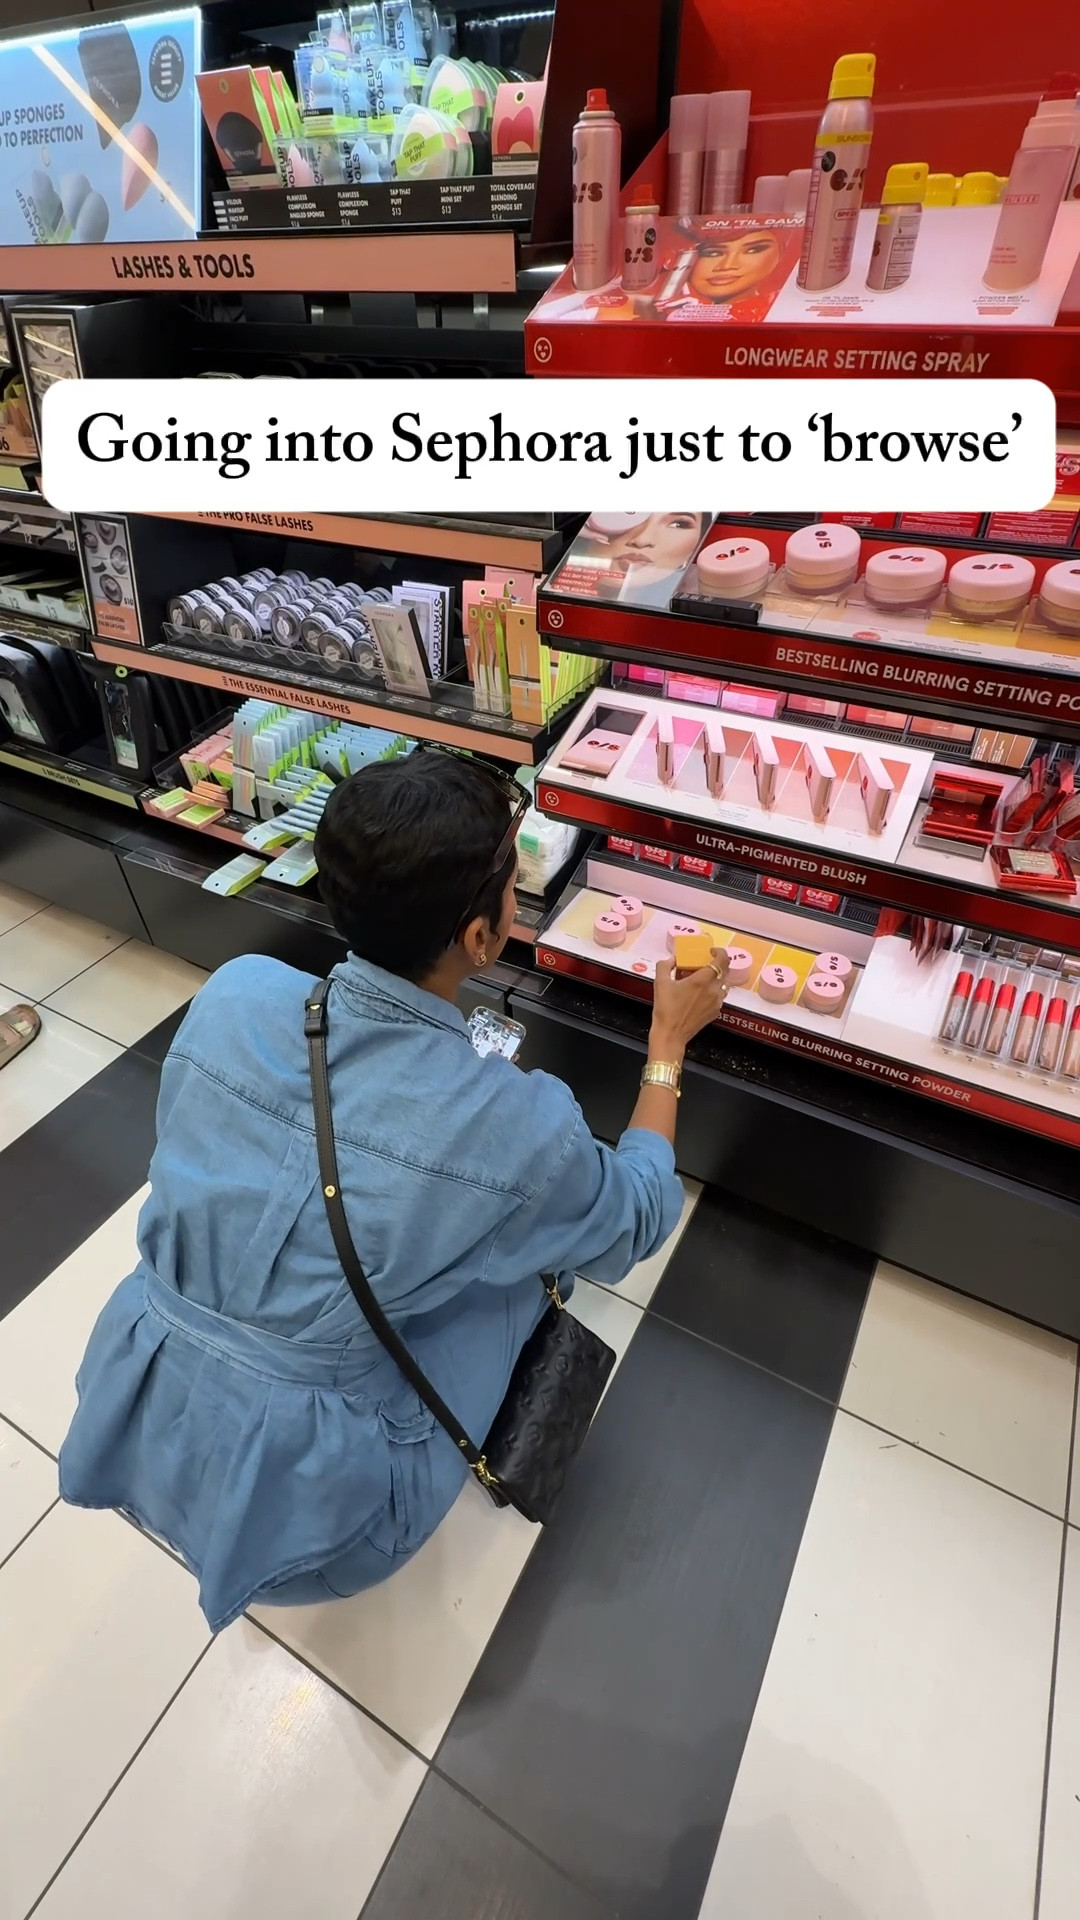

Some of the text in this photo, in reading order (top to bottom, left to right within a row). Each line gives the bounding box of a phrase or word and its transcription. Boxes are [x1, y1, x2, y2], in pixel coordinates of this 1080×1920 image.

[14, 103, 65, 125] SPONGES
[4, 124, 83, 147] TO PERFECTION
[404, 141, 426, 158] TAP THAT
[449, 185, 462, 193] THAT
[491, 193, 518, 201] BLENDING
[506, 183, 535, 191] COVERAGE
[442, 205, 452, 214] $13
[491, 203, 513, 211] SPONGE
[111, 253, 255, 279] LASHES & TOOLS
[724, 347, 990, 374] LONGWEAR SETTING SPRAY
[246, 512, 274, 526] FALSE
[274, 515, 314, 532] LASHES
[775, 647, 879, 677] BESTSELLING
[883, 665, 970, 692] BLURRING
[973, 680, 1052, 706] SETTING
[229, 678, 351, 715] THE ESSENTIAL FALSE LASHES
[695, 833, 868, 886] ULTRA-PIGMENTED BLUSH
[715, 1012, 972, 1103] BESTSELLING BLURRING SETTING POWDER
